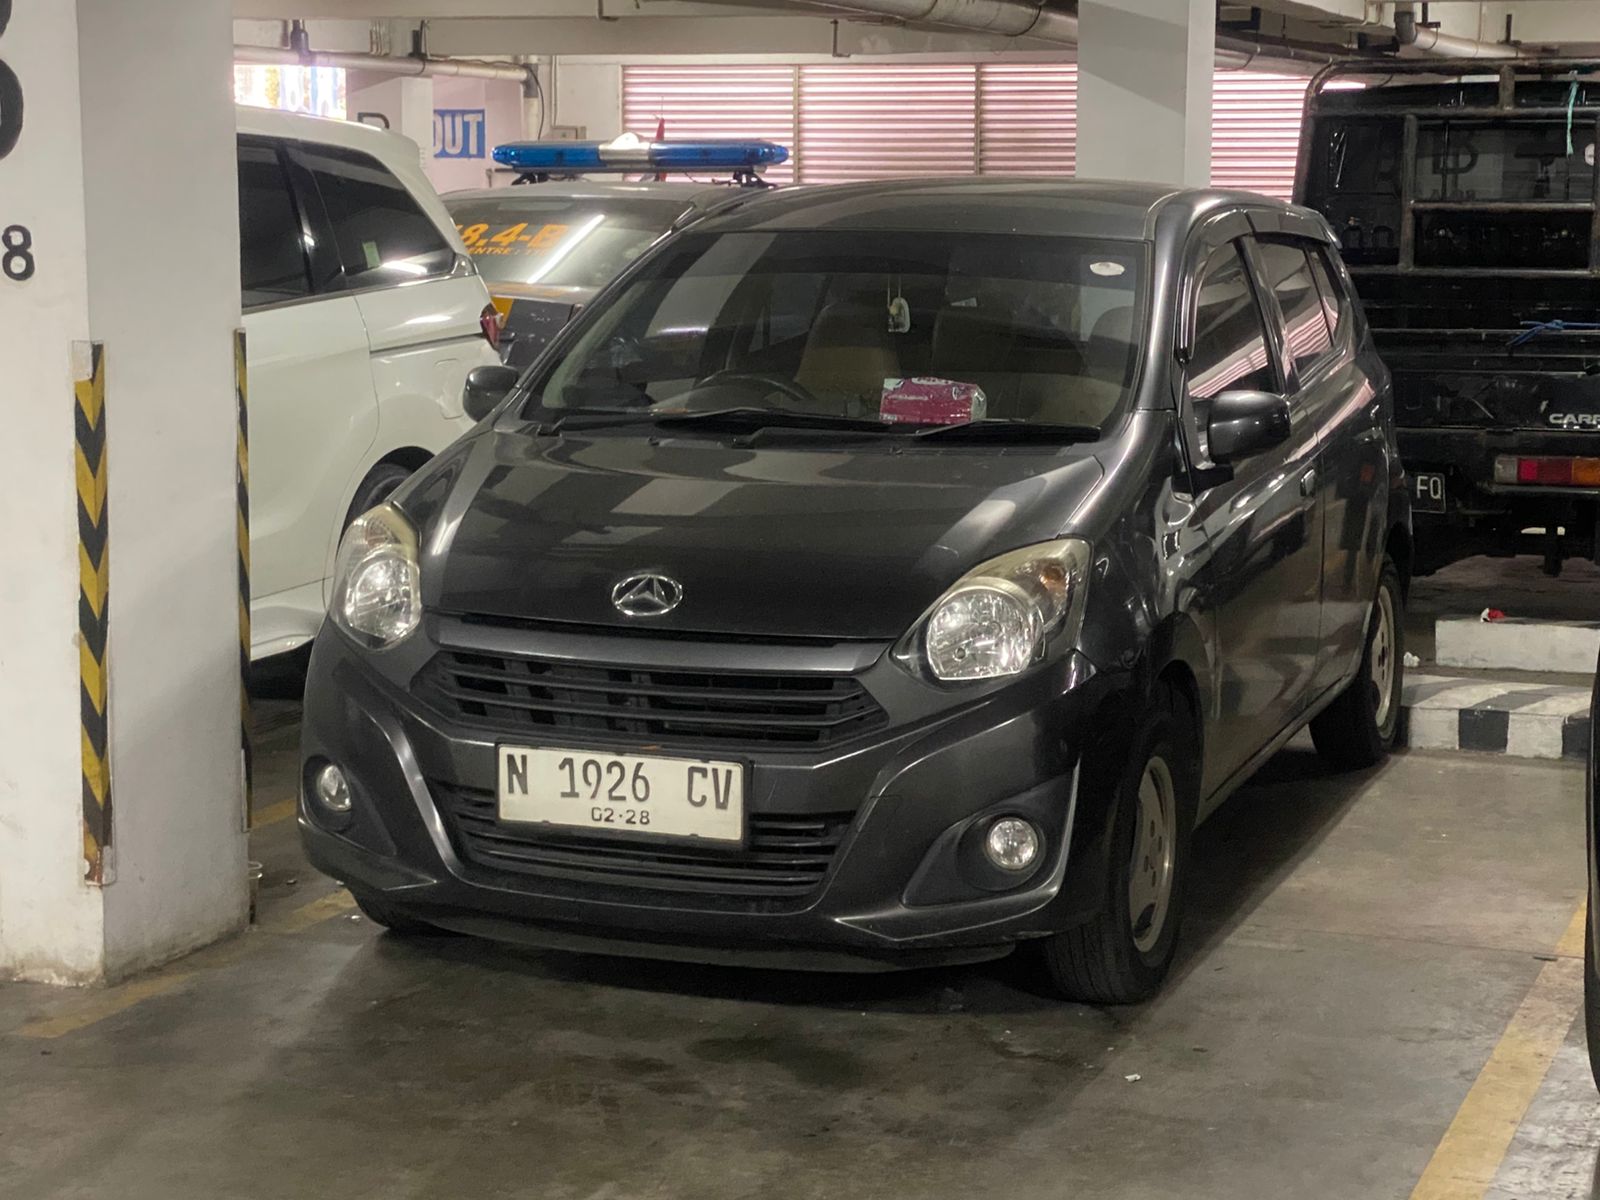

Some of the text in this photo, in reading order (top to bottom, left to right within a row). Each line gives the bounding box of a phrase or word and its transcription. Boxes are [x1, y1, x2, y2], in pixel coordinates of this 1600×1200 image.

[2, 224, 35, 281] 8
[1549, 413, 1600, 425] CAR
[506, 754, 733, 810] N 1926 CV
